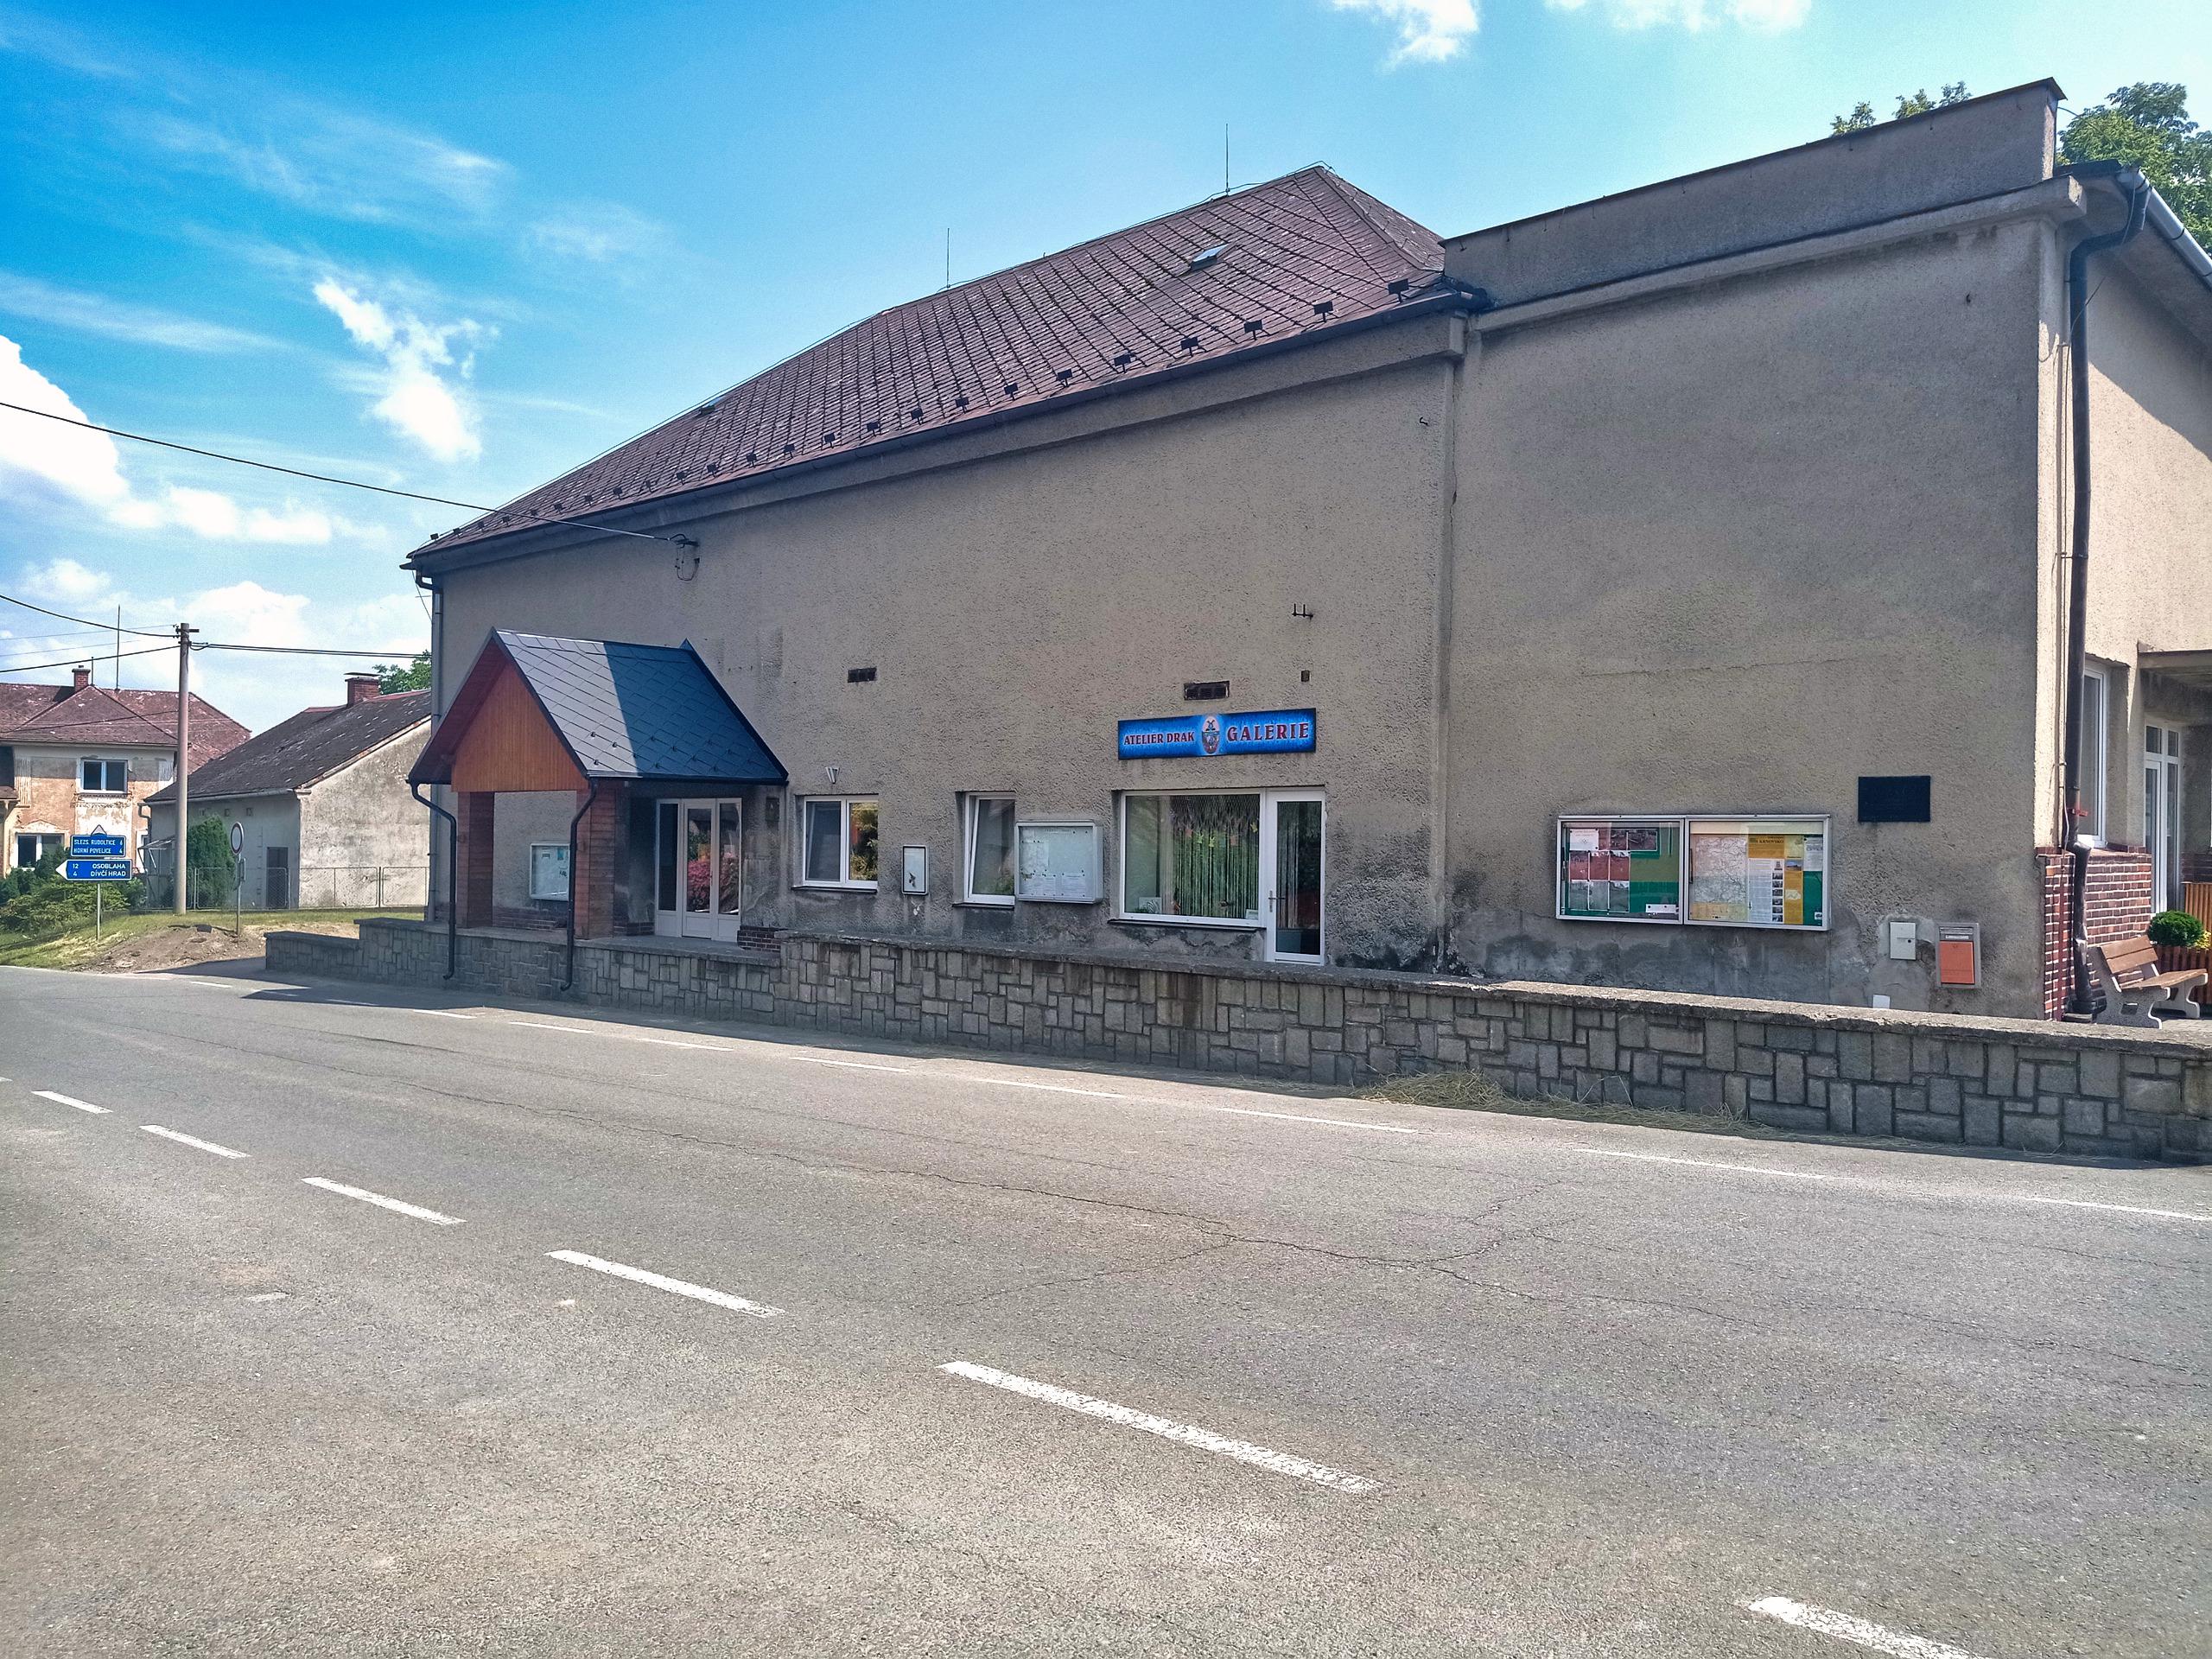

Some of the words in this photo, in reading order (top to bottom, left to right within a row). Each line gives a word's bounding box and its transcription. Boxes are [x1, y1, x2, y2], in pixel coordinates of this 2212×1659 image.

[1124, 733, 1164, 745] ATELIER
[1166, 732, 1195, 743] DRAK
[1227, 722, 1309, 741] GALERIE
